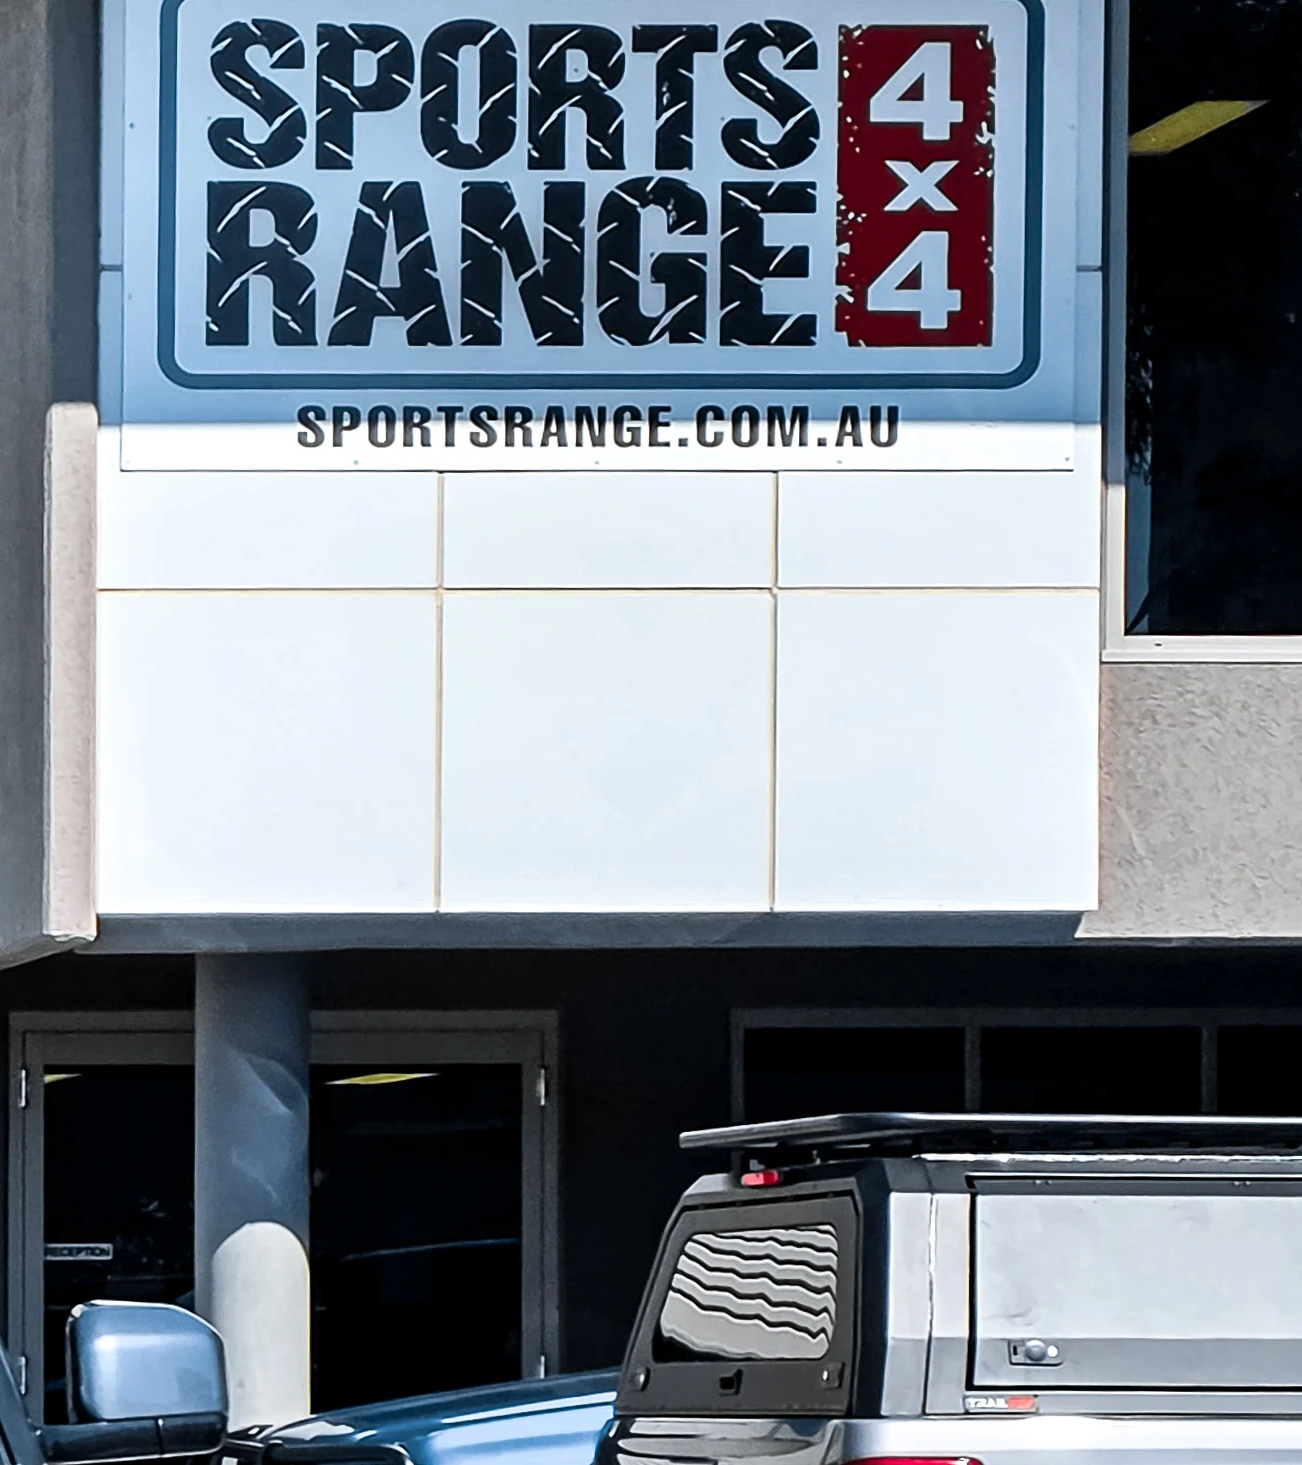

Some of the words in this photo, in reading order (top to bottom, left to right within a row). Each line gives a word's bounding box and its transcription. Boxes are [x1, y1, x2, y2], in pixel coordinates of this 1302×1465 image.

[206, 18, 819, 172] SPORTS
[204, 176, 817, 348] RANGE
[296, 404, 901, 450] SPORTSRANGE.COM.AU
